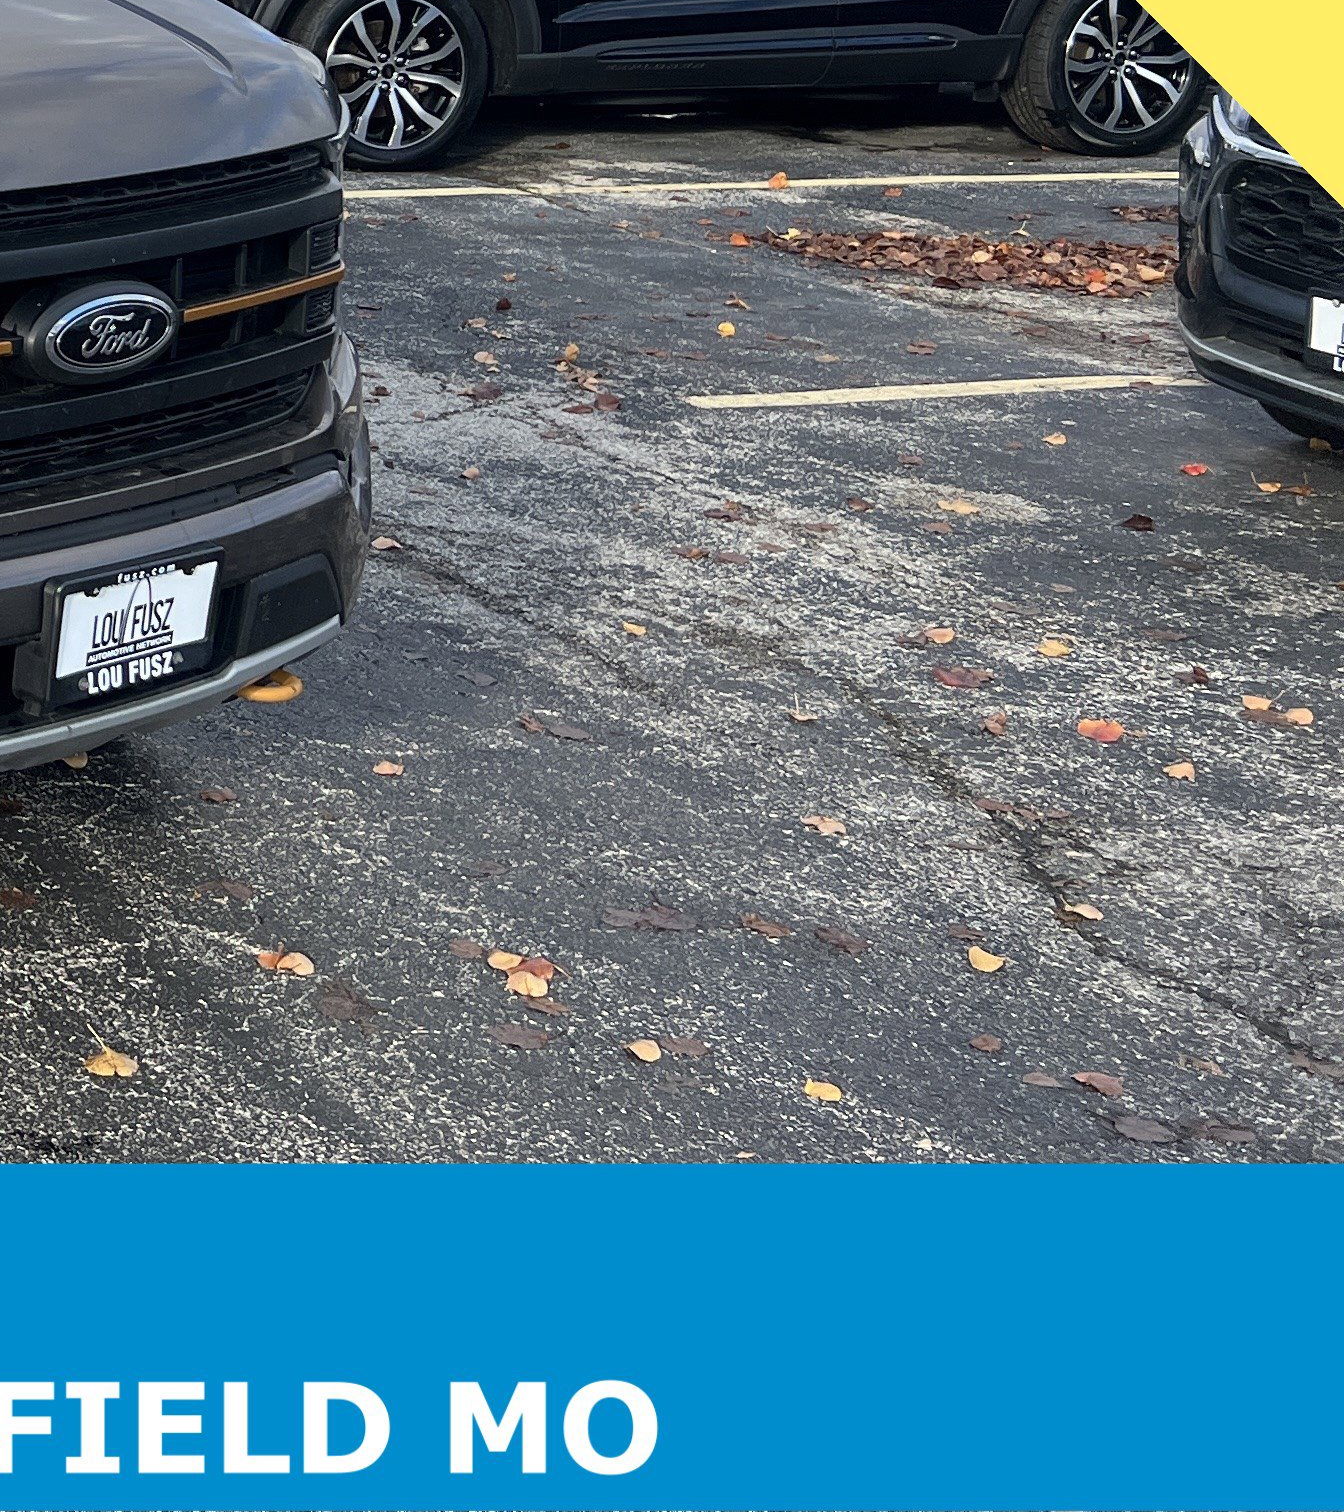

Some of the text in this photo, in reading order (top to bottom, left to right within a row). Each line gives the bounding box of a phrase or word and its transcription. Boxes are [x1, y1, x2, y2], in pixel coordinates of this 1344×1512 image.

[81, 312, 152, 359] Ford
[117, 563, 176, 584] fusz.com
[92, 597, 175, 649] LOU FUSZ
[87, 634, 172, 664] AUTOMOTIVE NETWORK
[87, 651, 174, 695] LOU FUSZ
